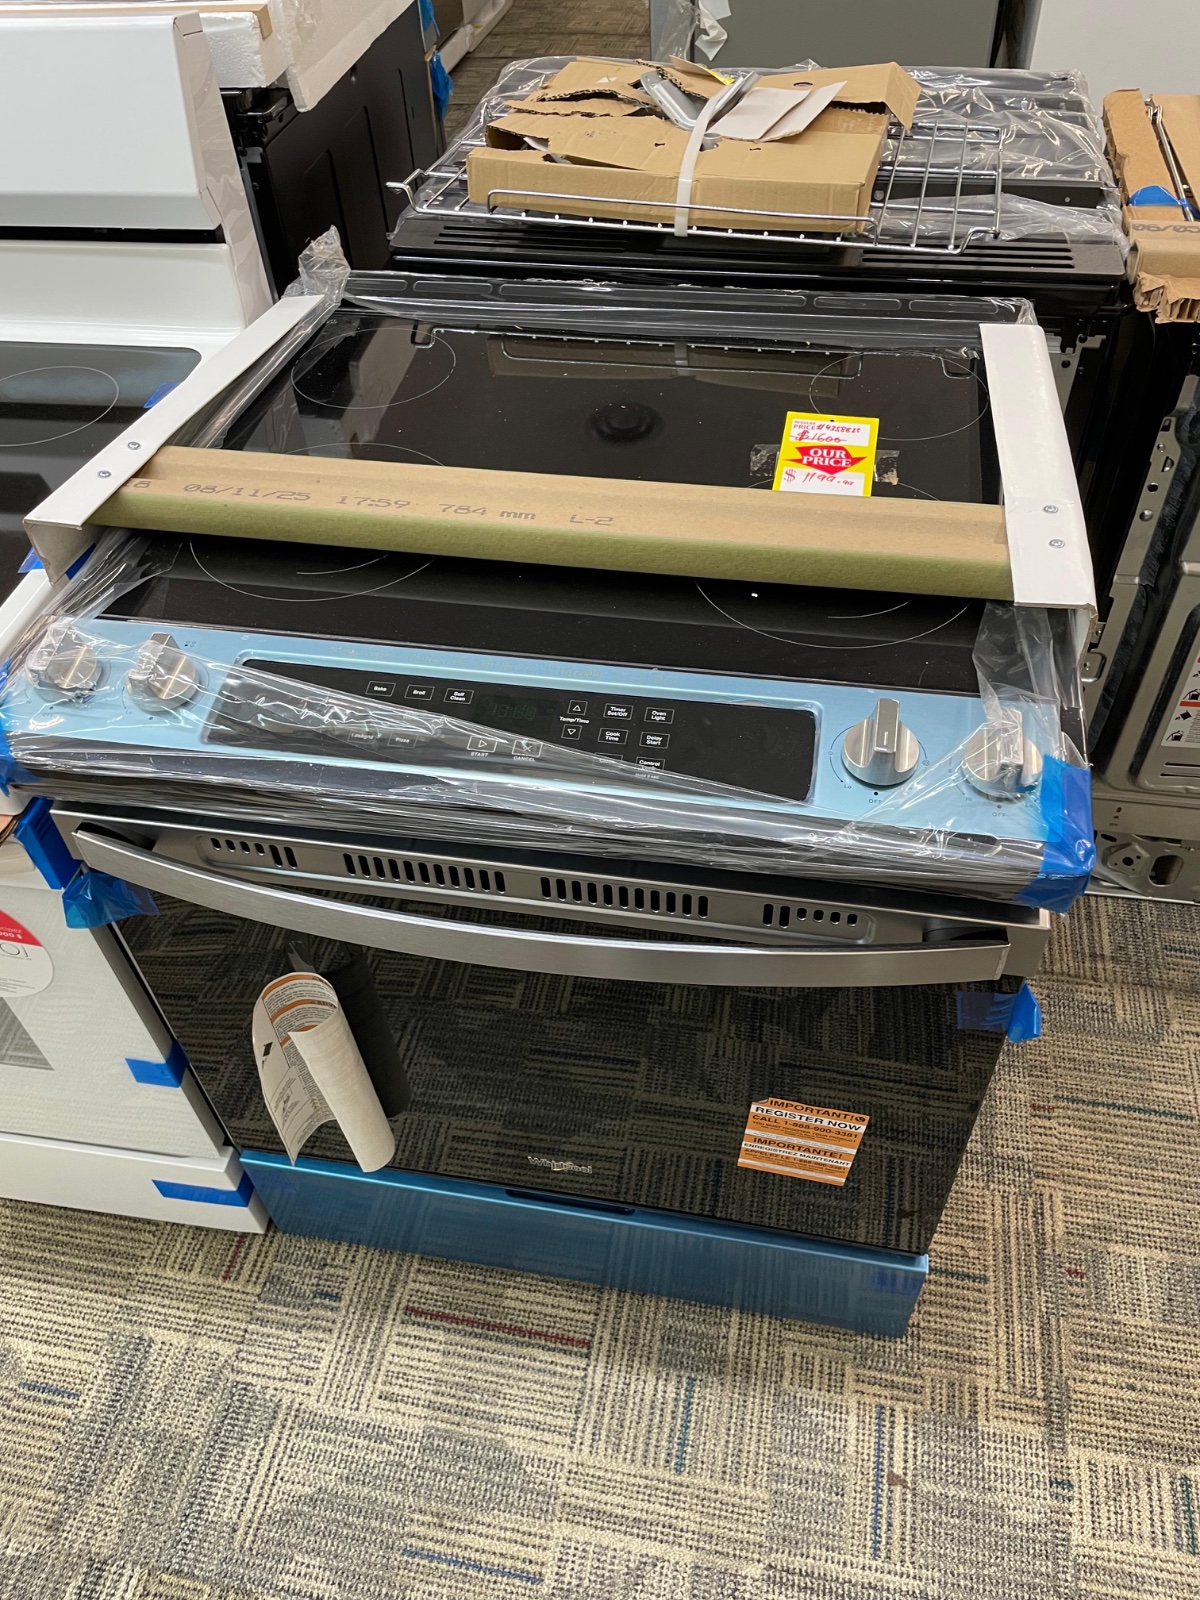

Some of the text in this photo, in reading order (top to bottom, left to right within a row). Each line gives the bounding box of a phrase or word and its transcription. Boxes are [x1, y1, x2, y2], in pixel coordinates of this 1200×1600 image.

[802, 456, 852, 467] PRICE
[809, 448, 847, 458] OUR
[182, 483, 311, 501] 08/11/25
[336, 494, 411, 509] 17:59
[439, 503, 487, 516] 784
[499, 510, 536, 520] mm
[569, 514, 614, 526] L-2
[560, 716, 590, 724] Temp/Time
[755, 1106, 862, 1131] REGISTER NOW
[769, 1099, 854, 1121] IMPORTANT!
[752, 1114, 779, 1124] CALL
[784, 1120, 858, 1139] 1-888-900-3381
[743, 1142, 797, 1156] ENREGISTREZ
[799, 1153, 850, 1166] MAINTENANT
[744, 1148, 779, 1159] APPELEZ
[527, 1155, 593, 1174] Whirlpool
